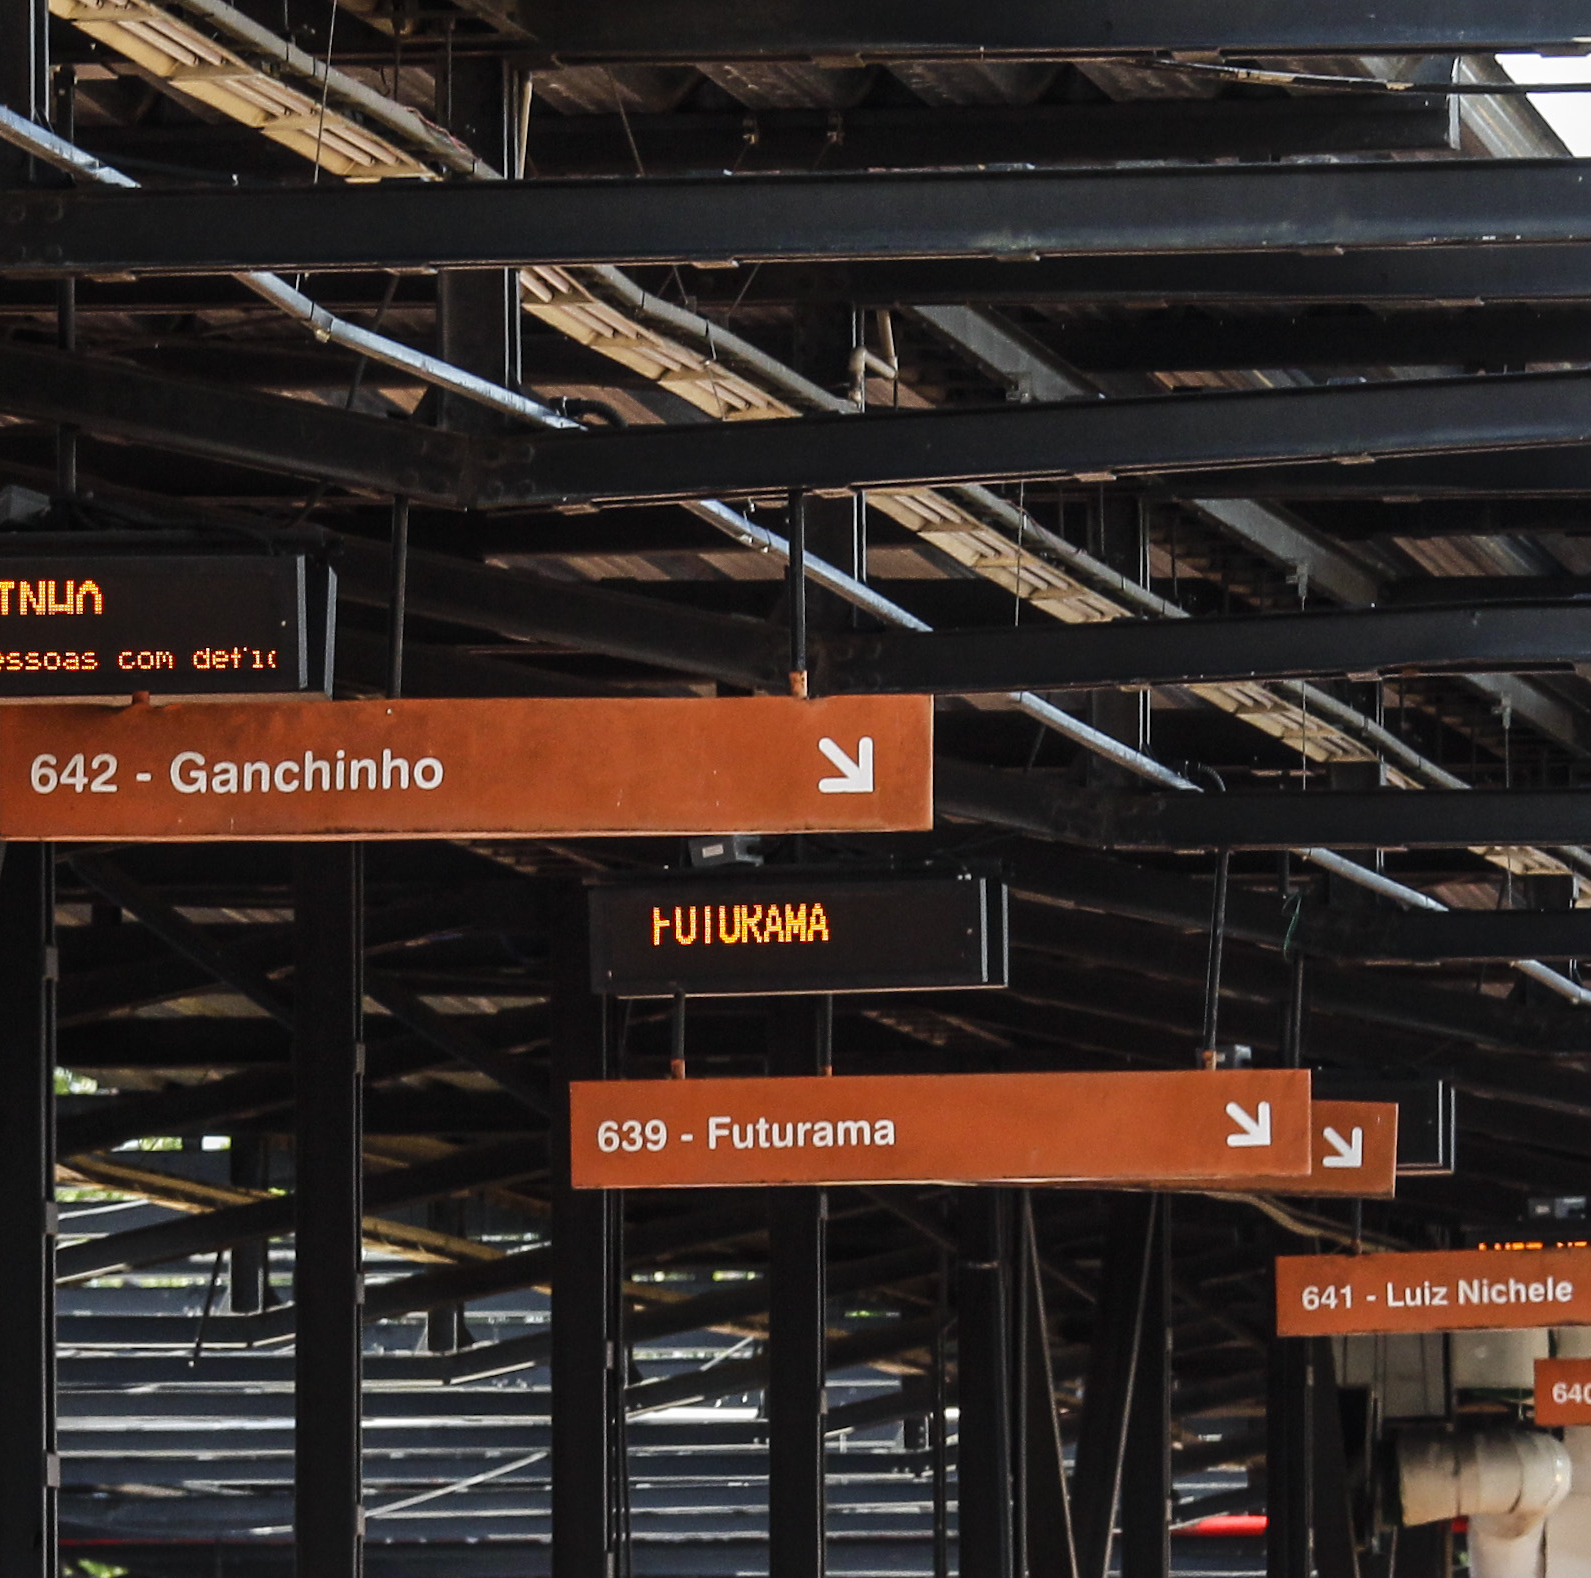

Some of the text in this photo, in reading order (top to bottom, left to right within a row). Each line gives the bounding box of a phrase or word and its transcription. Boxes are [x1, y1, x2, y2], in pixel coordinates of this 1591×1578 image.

[116, 649, 176, 671] com
[30, 752, 118, 794] 642
[169, 747, 445, 794] Ganchinho
[596, 1118, 668, 1153] 639
[707, 1115, 897, 1151] Futurama
[1301, 1284, 1354, 1311] 641
[1386, 1280, 1450, 1308] Luiz
[1457, 1275, 1574, 1306] Nichele
